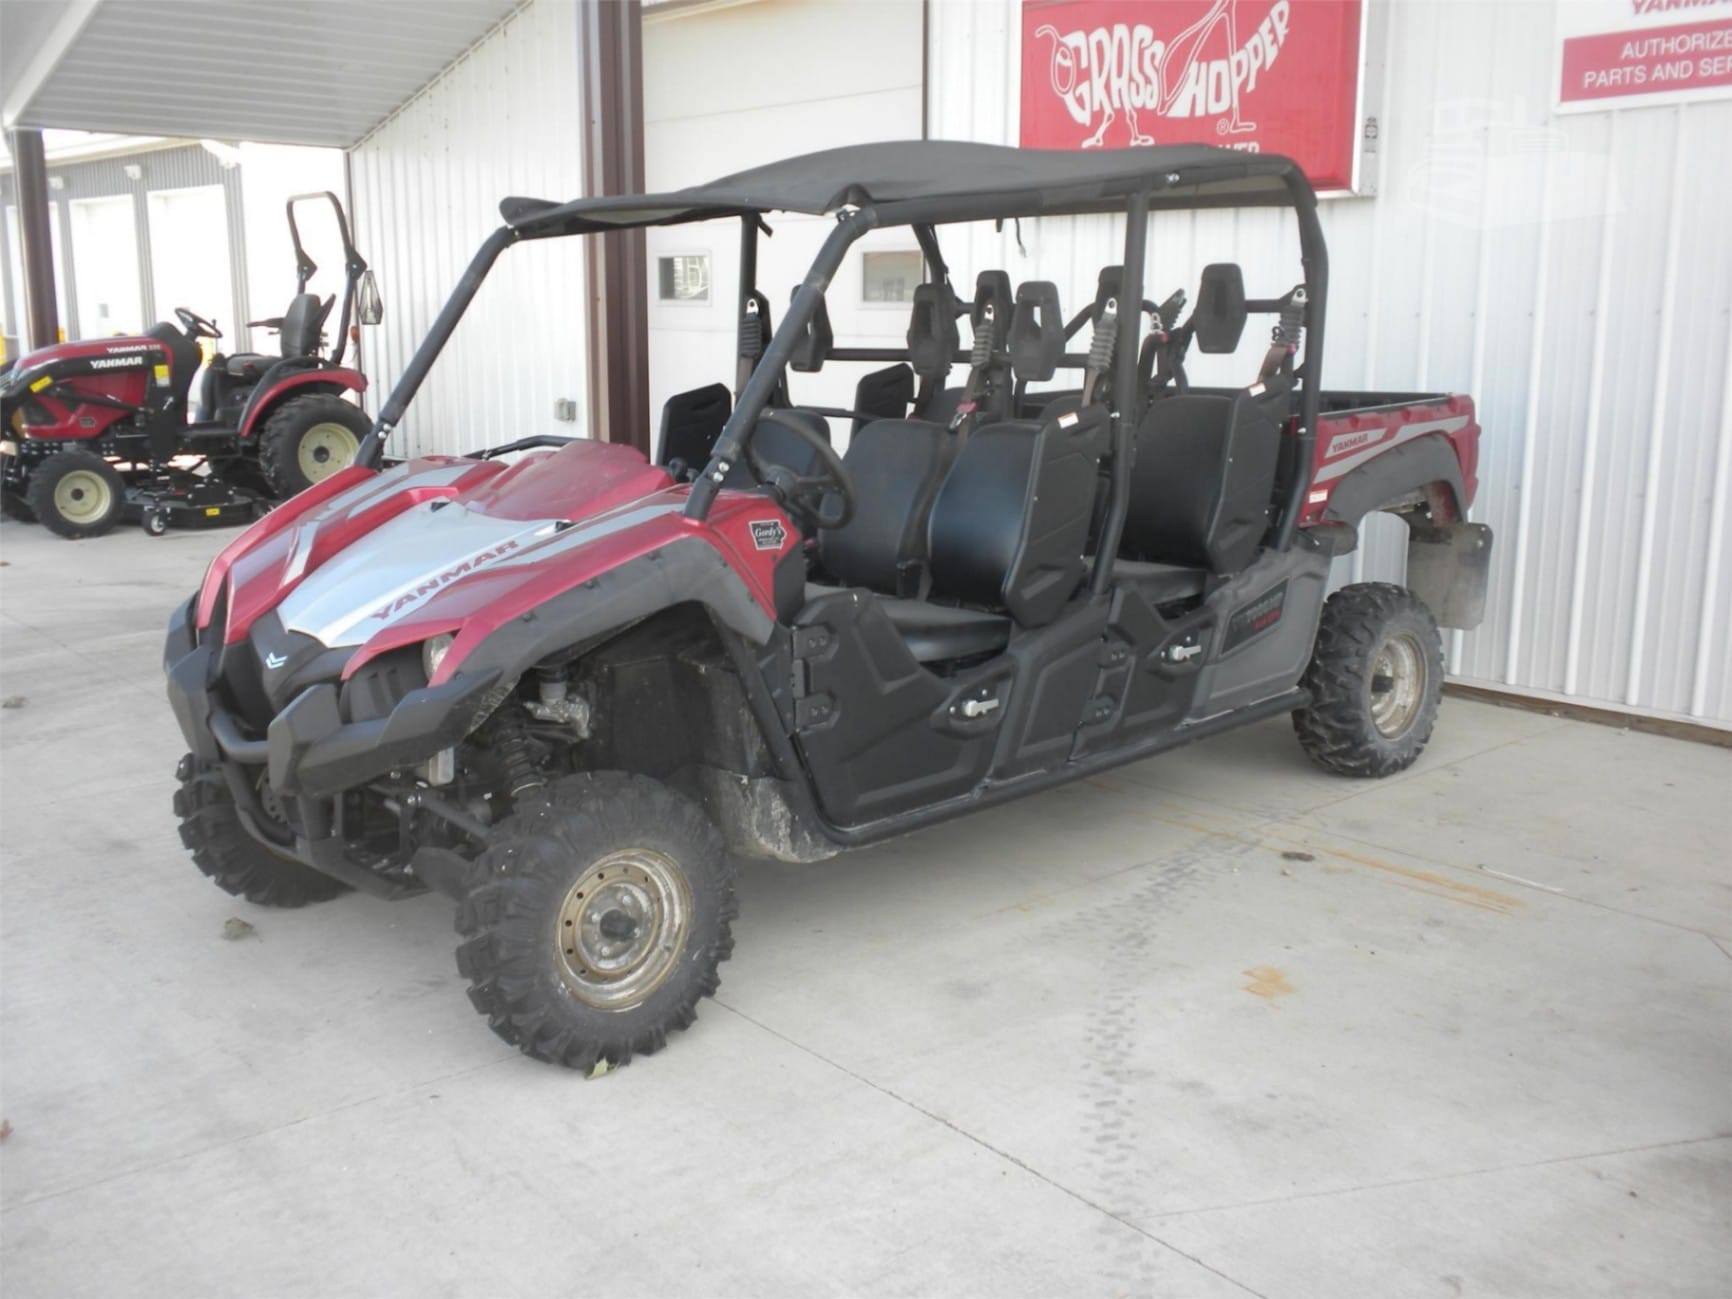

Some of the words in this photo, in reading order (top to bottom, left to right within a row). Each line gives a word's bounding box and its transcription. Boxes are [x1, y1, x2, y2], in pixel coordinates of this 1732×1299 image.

[1584, 65, 1647, 88] PARTS
[1651, 60, 1694, 81] AND
[106, 345, 147, 354] YANMAR
[90, 356, 143, 369] YANMAR
[1332, 432, 1369, 453] YANMAR
[370, 540, 519, 620] YANMAR
